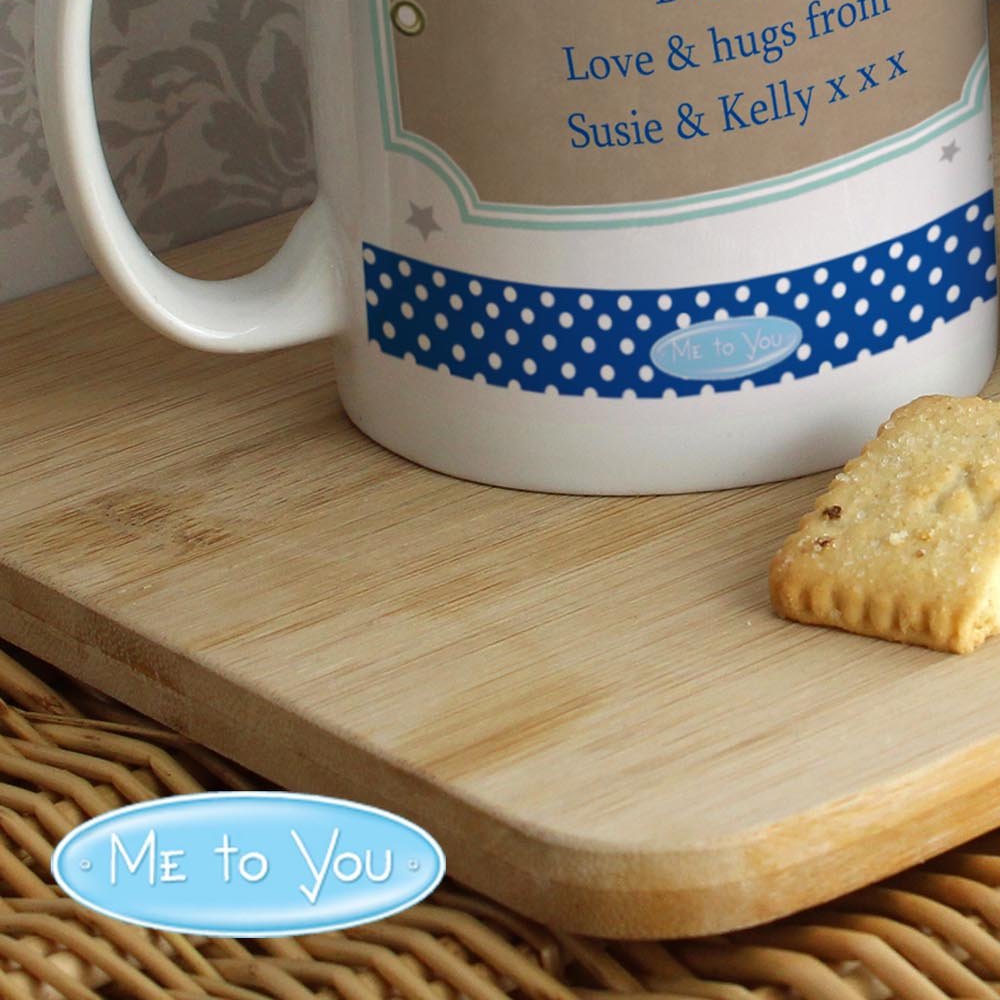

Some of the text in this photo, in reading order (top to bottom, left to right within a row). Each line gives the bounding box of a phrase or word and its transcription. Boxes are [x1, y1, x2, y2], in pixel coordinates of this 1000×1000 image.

[562, 46, 655, 80] Love
[667, 34, 700, 71] &
[707, 20, 797, 64] hugs
[567, 110, 664, 148] Susie
[676, 101, 709, 140] &
[717, 79, 815, 132] Kelly
[713, 336, 735, 357] to
